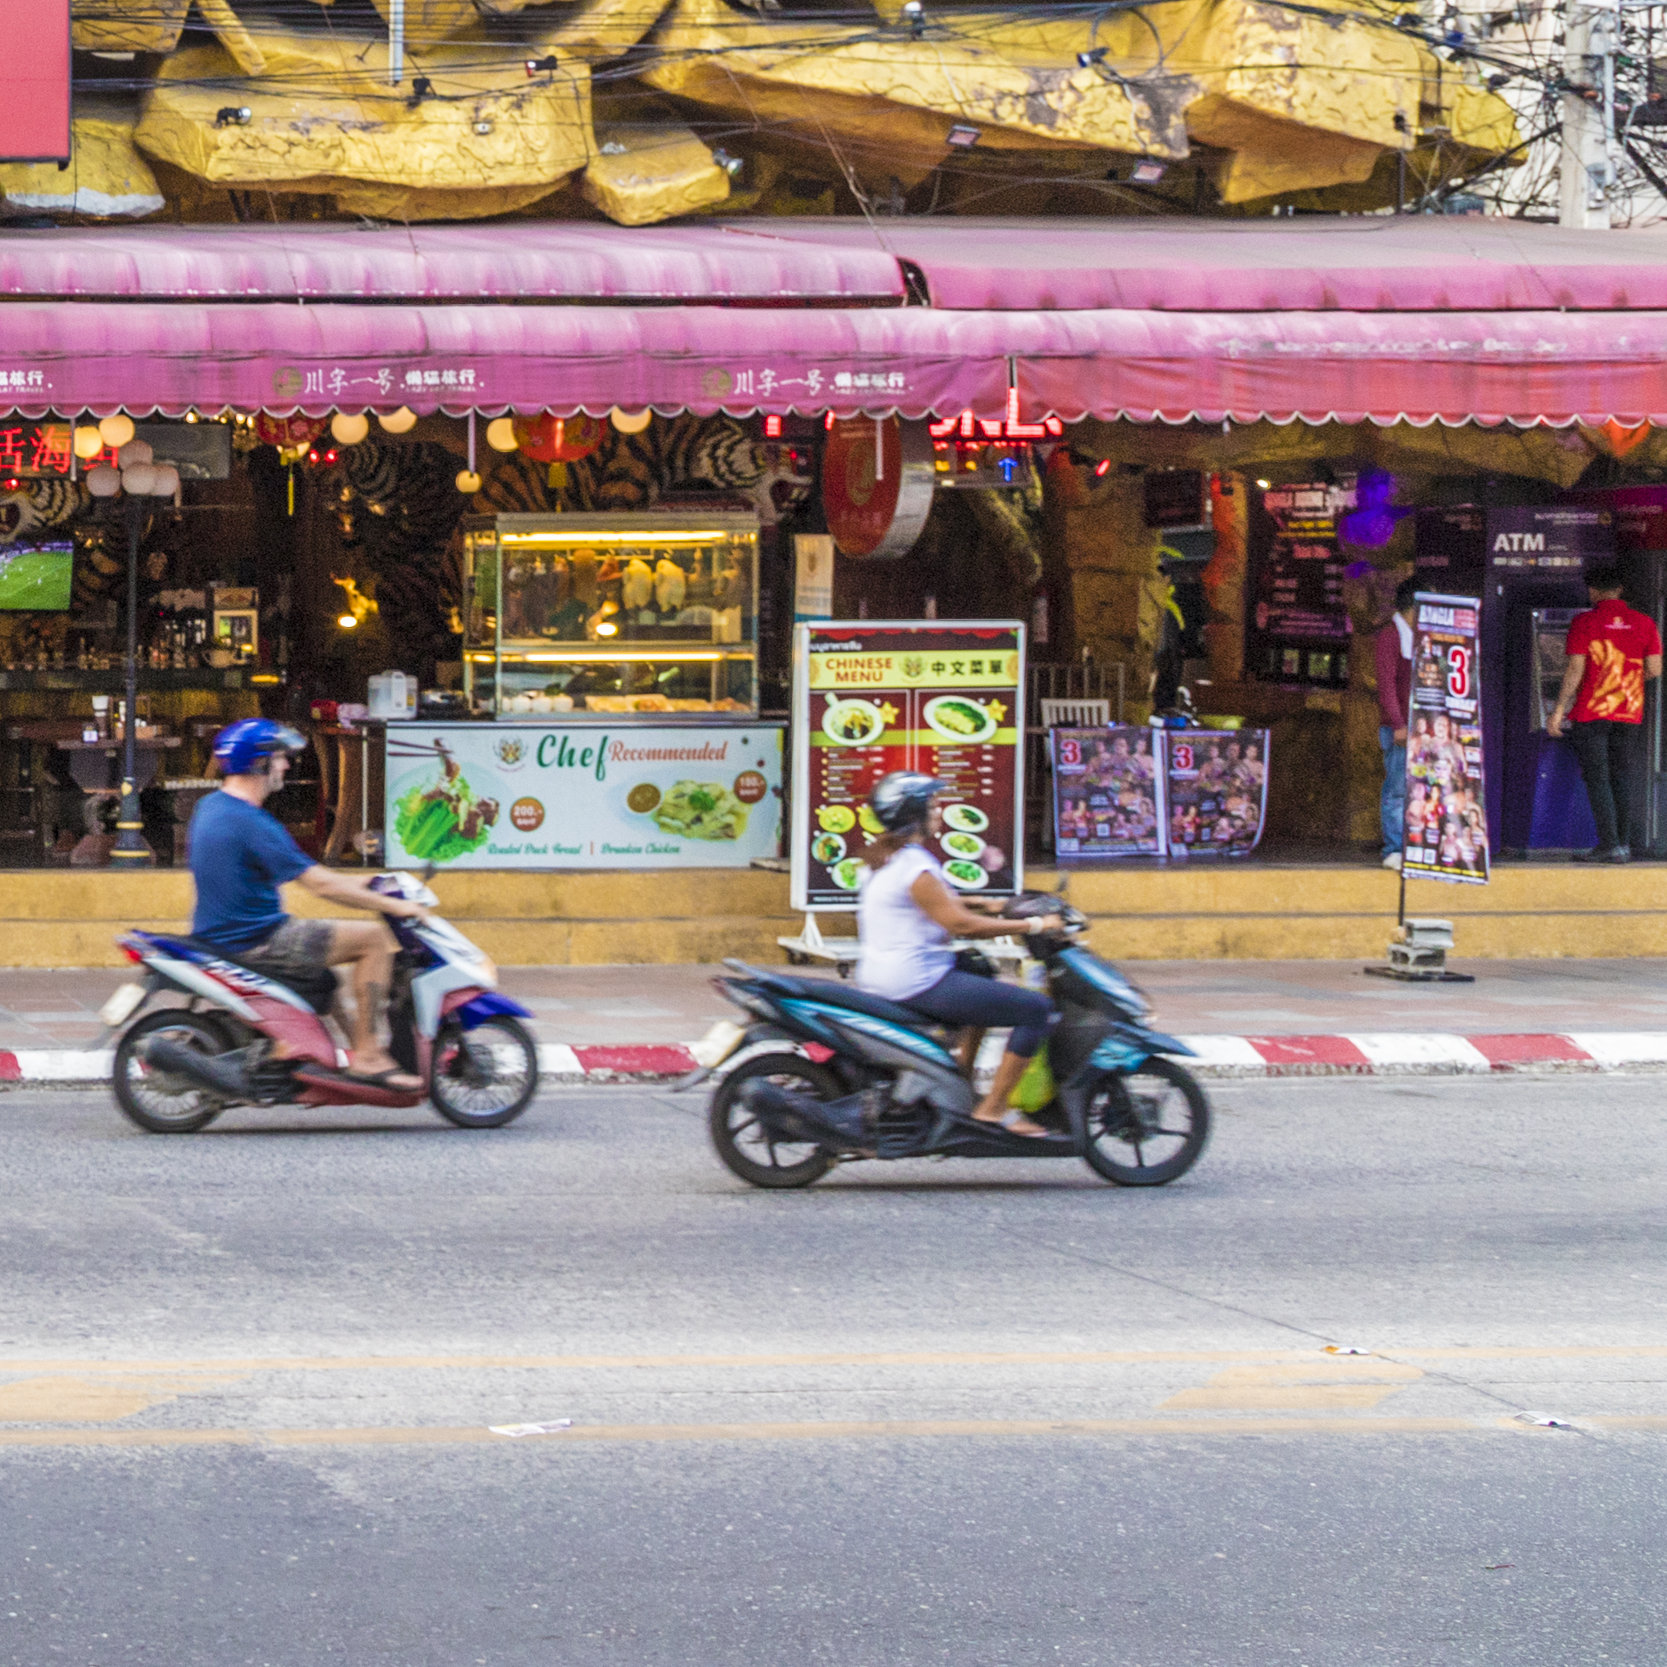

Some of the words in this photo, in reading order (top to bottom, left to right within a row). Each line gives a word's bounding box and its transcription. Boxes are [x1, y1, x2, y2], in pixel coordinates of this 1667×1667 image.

[305, 368, 395, 395] 川字一号
[734, 369, 825, 396] 川字一号
[1493, 533, 1545, 551] ATM
[826, 658, 893, 670] CHINESE
[835, 671, 884, 683] MENU
[536, 734, 608, 782] Chef
[608, 740, 728, 762] Recommended
[1061, 739, 1082, 764] 3
[1172, 744, 1194, 770] 3
